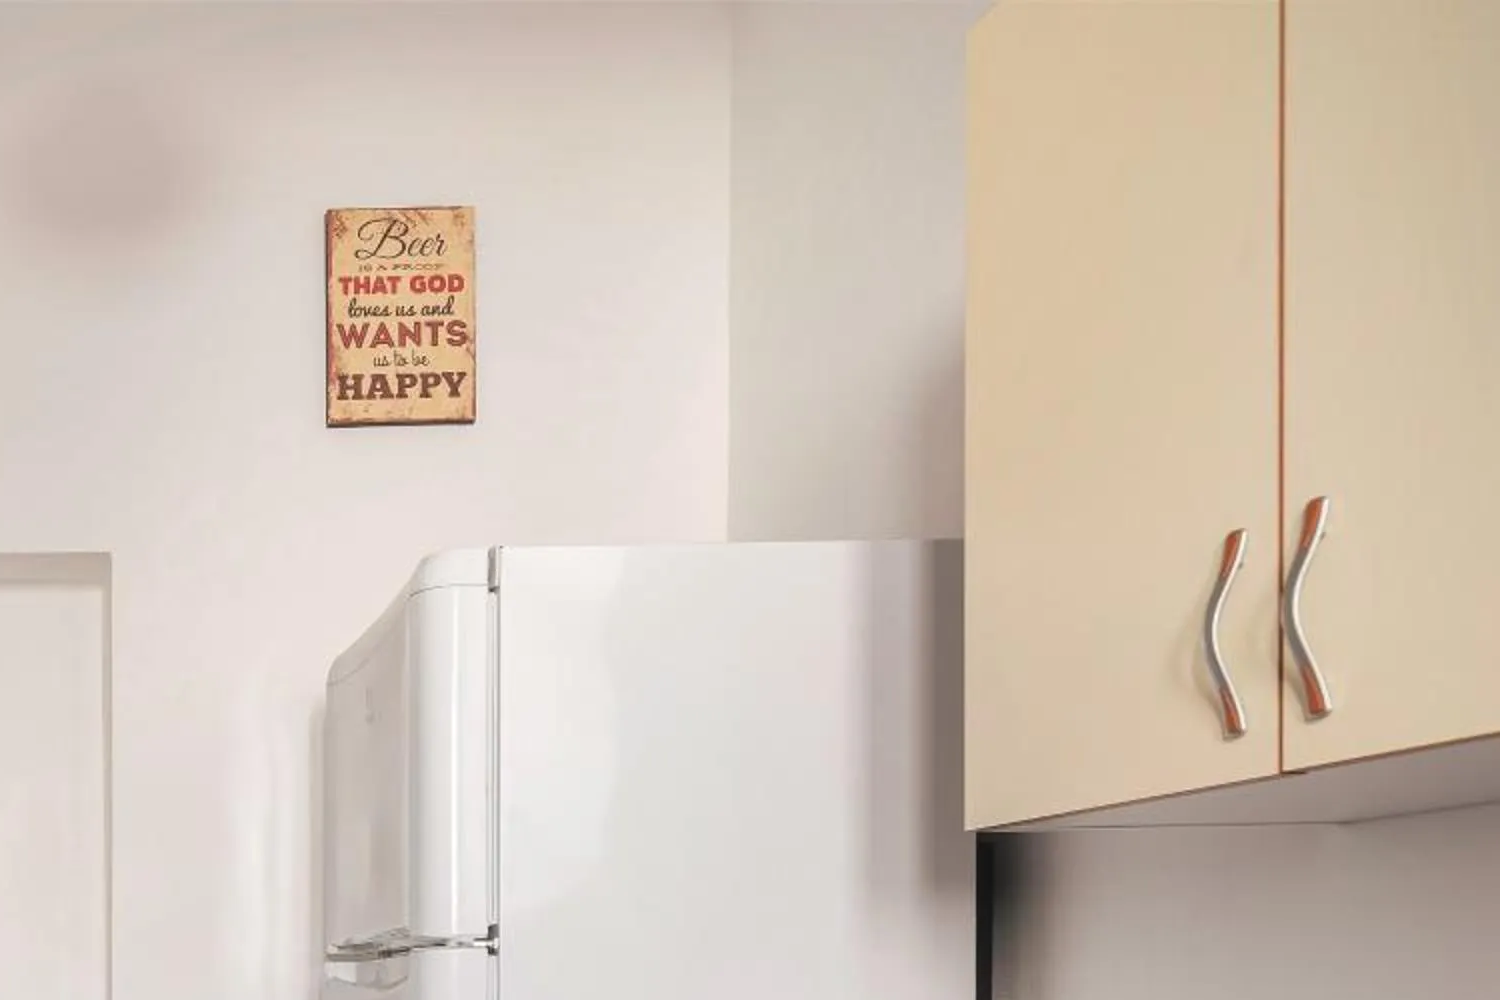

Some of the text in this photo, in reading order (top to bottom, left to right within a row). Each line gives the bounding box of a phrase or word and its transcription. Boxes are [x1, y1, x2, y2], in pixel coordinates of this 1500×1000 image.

[355, 218, 447, 260] Beer
[338, 274, 465, 294] THAT GOD
[348, 296, 455, 318] loves us and
[336, 320, 468, 348] WANTS
[373, 350, 430, 367] us to be
[336, 371, 468, 400] HAPPY
